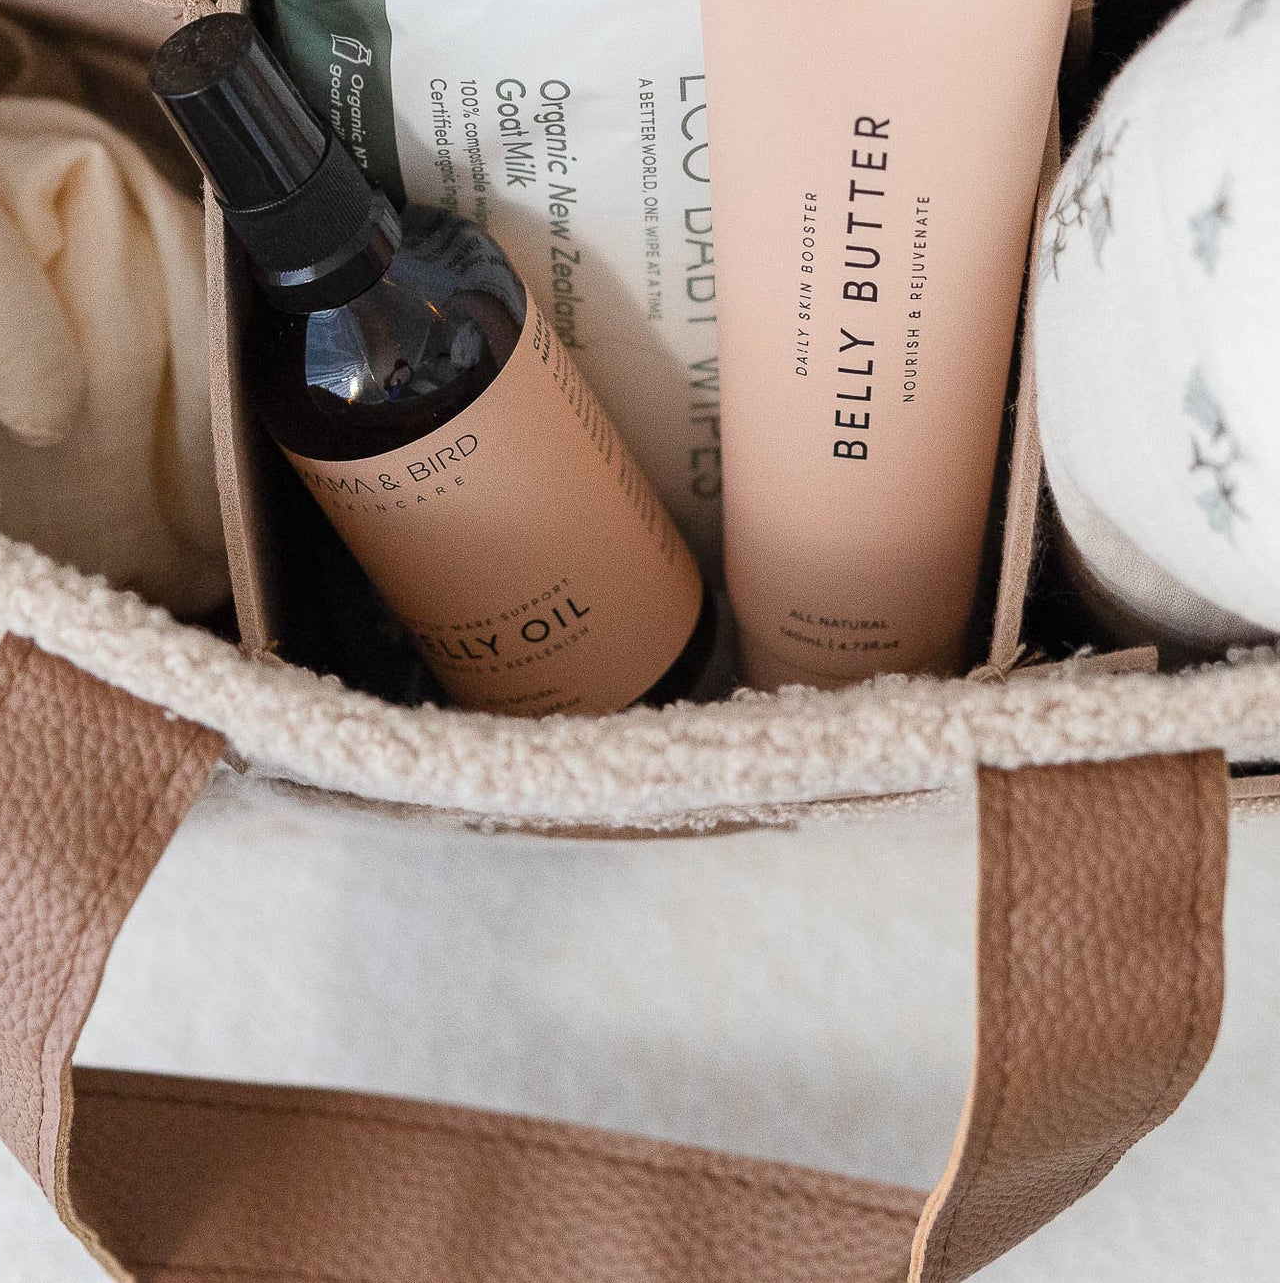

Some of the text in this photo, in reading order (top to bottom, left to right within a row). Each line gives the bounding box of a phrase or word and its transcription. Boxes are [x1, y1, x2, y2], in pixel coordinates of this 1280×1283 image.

[330, 63, 344, 107] goat
[347, 74, 366, 143] Organic
[430, 78, 454, 146] Certified
[460, 79, 481, 119] 100%
[463, 122, 491, 193] compostable
[495, 78, 537, 189] Goat Milk
[533, 79, 578, 175] Organic
[434, 149, 461, 183] organic
[638, 77, 663, 321] A BETTER WORLD, ONE WIPE AT A TIME
[548, 182, 578, 241] New
[551, 246, 587, 350] Zealand
[795, 192, 818, 377] DAILY SKIN BOOSTER
[833, 116, 891, 460] BELLY BUTTER
[903, 196, 931, 403] NOURISH & REJUVENATE
[378, 473, 402, 491] &
[407, 434, 478, 482] BIRD
[500, 577, 570, 621] SUPPORT
[521, 598, 591, 643] OIL
[818, 617, 888, 630] NATURAL
